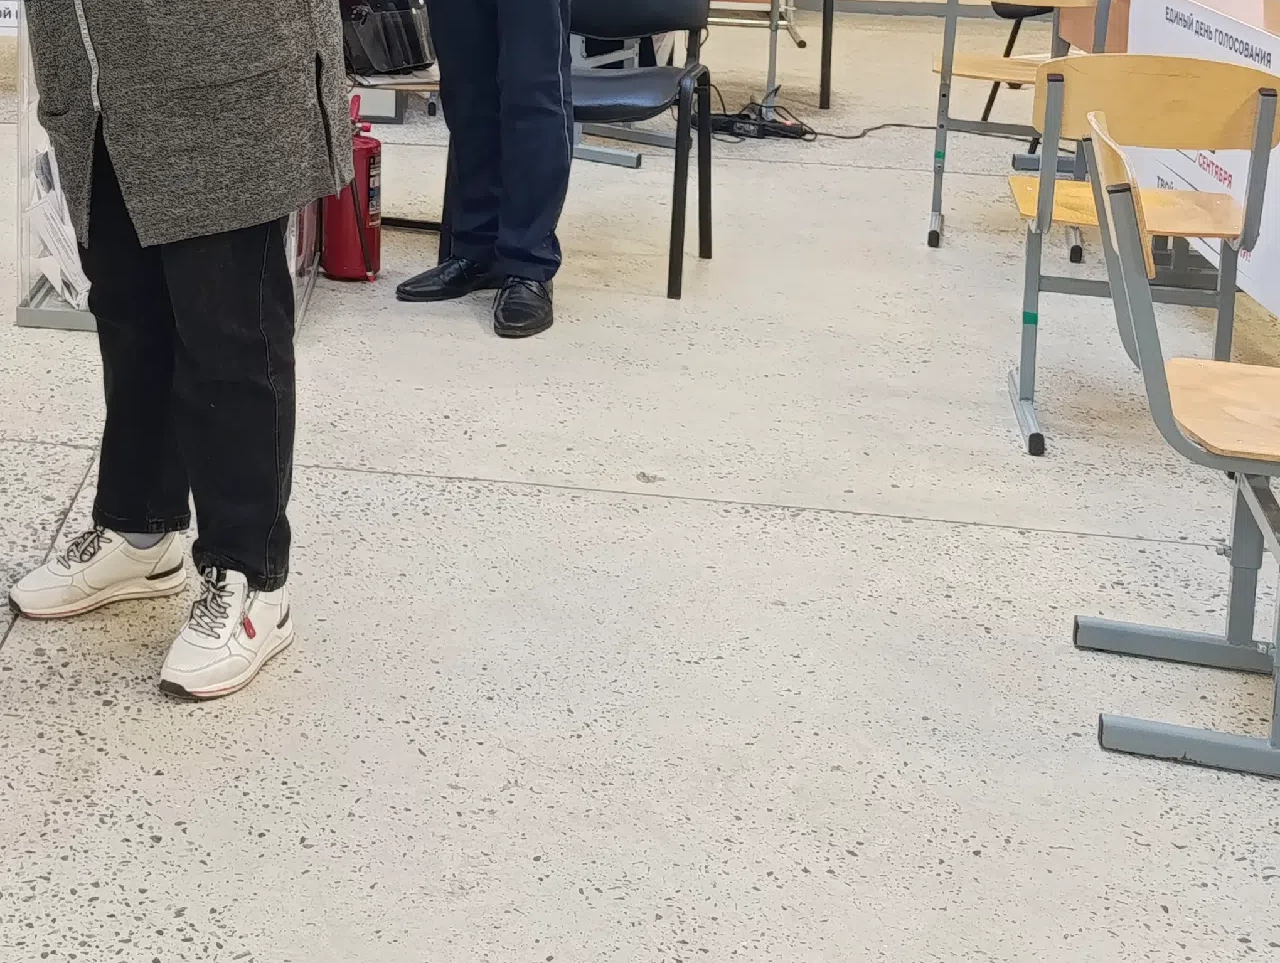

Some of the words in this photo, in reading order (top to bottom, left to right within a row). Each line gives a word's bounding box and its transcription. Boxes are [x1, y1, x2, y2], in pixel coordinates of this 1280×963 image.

[1165, 6, 1194, 31] ЕДИНЫЙ
[1194, 20, 1213, 41] ДЕНЬ
[1214, 28, 1272, 69] ГОЛОСОВАНИЯ
[1198, 153, 1233, 190] СЕНТЯБРЯ
